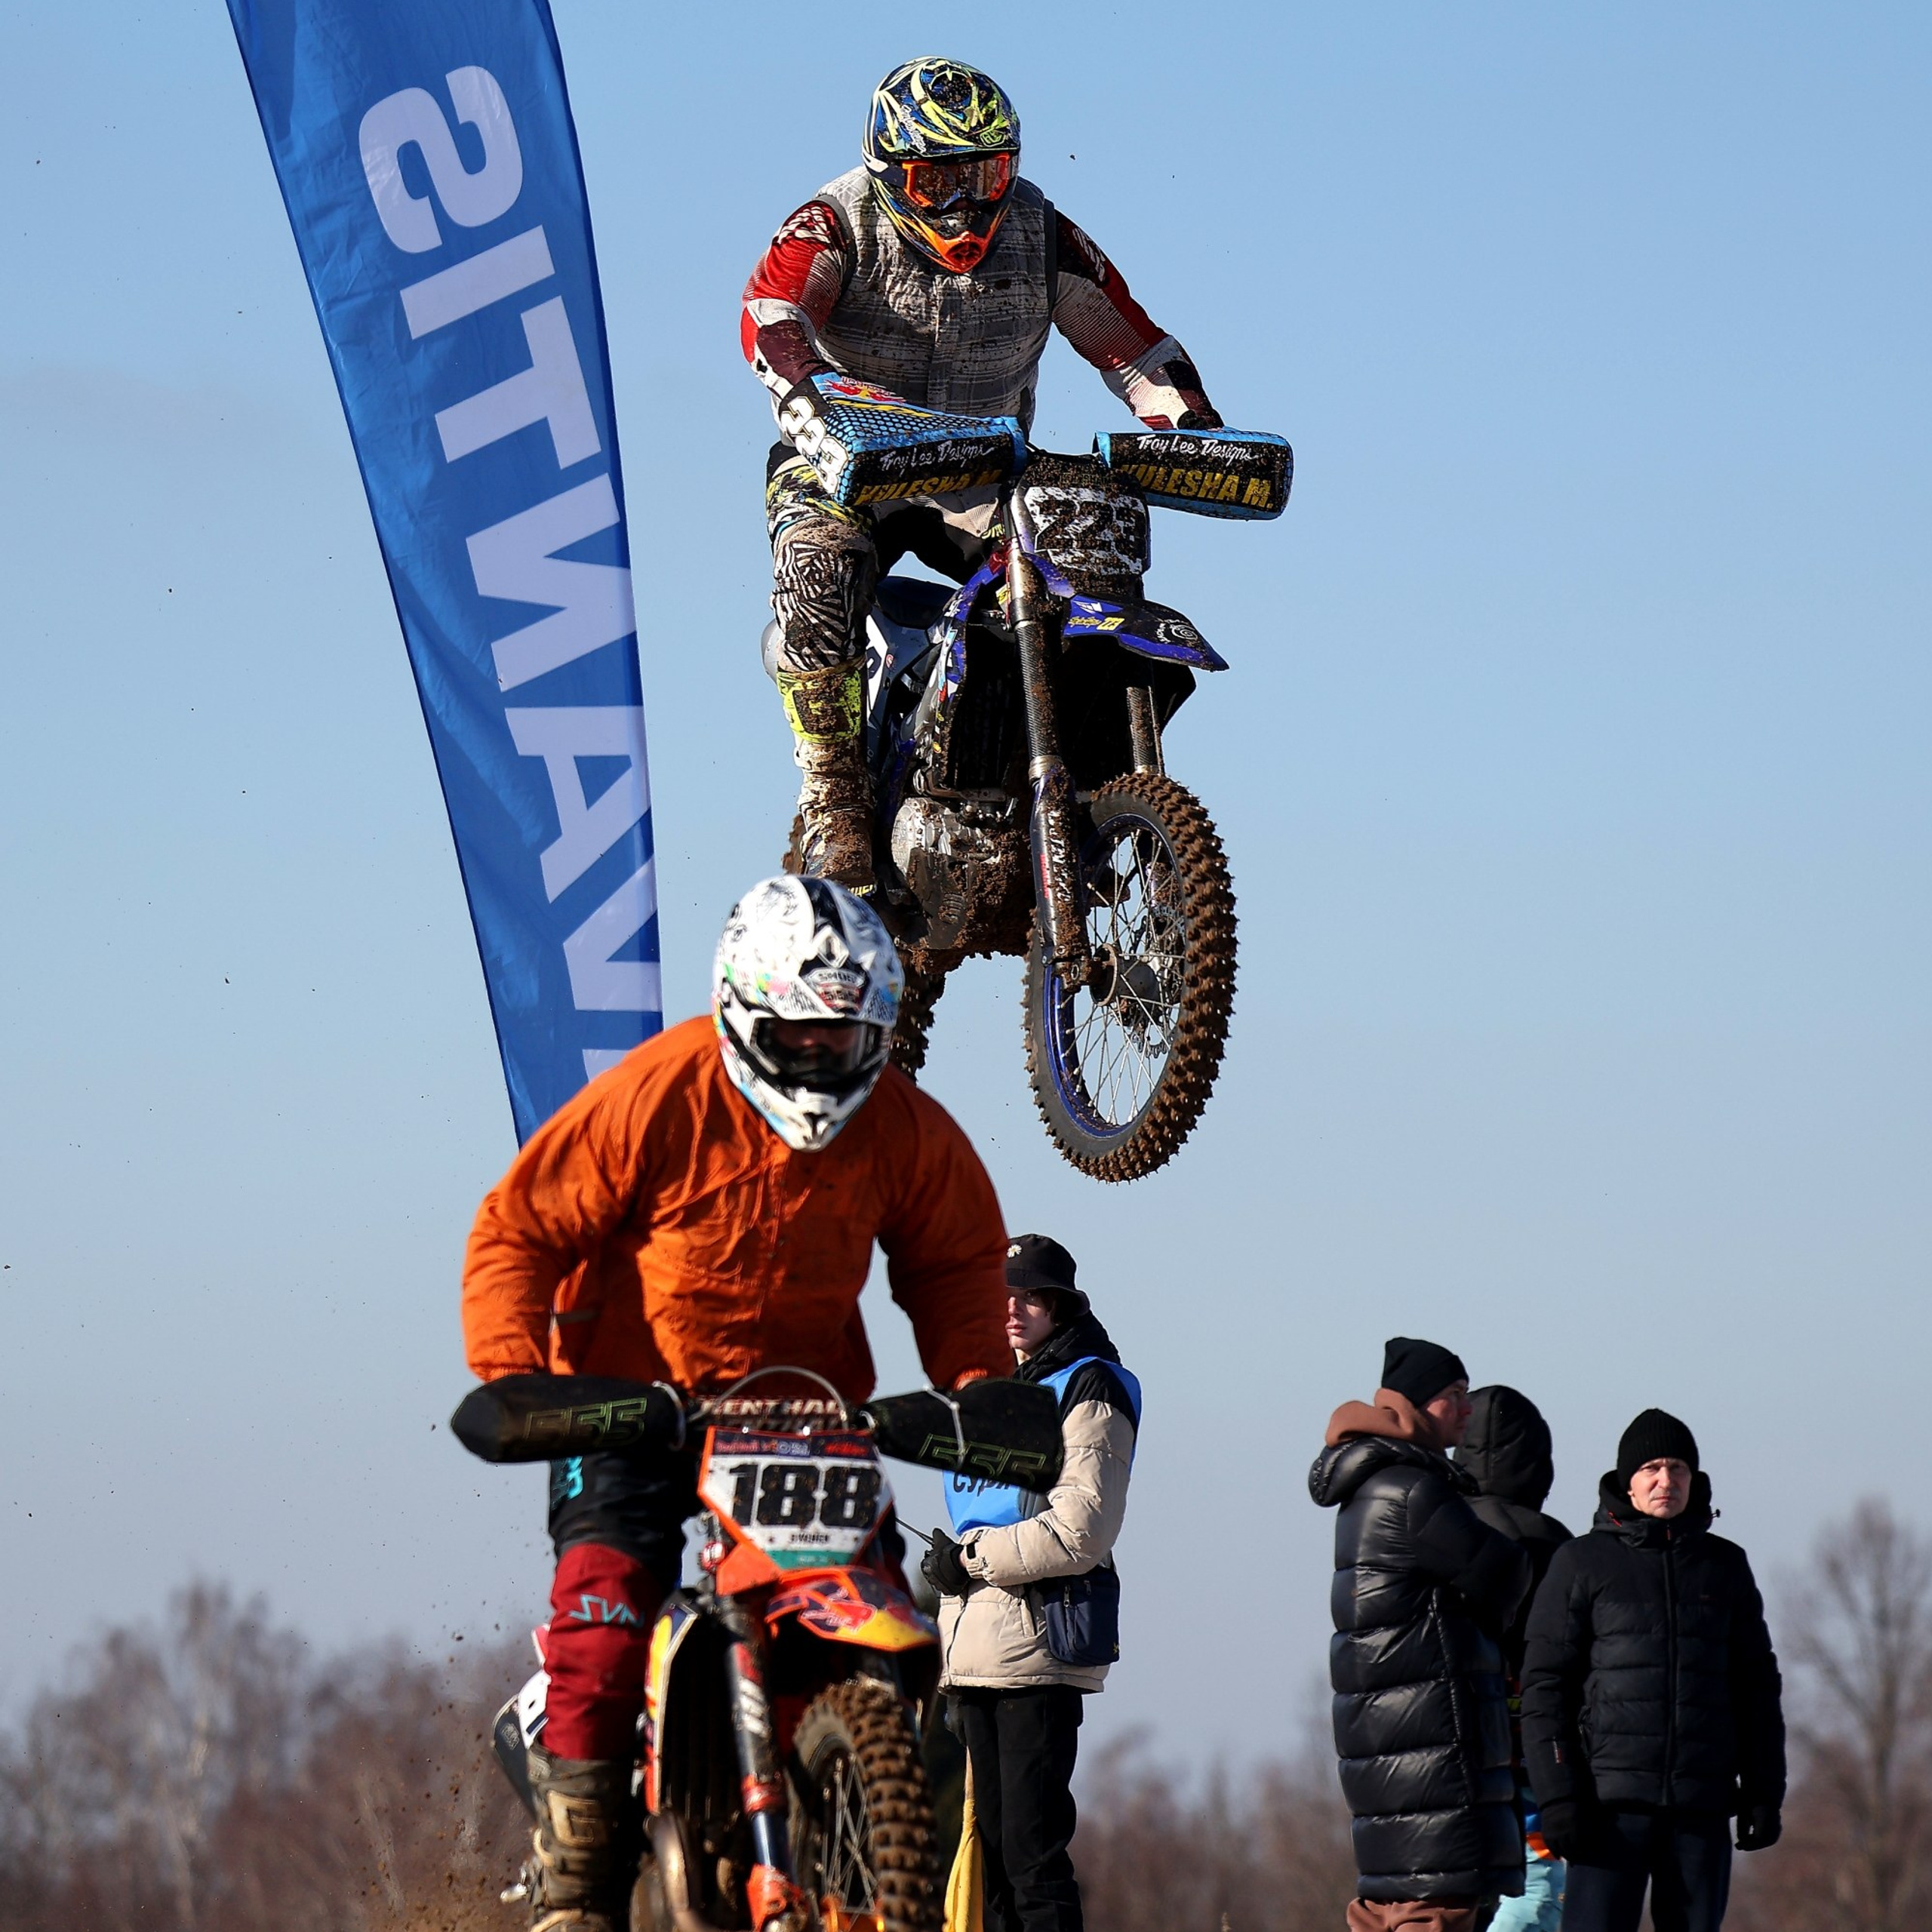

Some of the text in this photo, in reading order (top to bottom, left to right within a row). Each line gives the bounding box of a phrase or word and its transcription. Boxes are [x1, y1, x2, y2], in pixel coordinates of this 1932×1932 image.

[880, 440, 995, 477] Troy Lee Designs
[1137, 434, 1259, 467] Troy Lee Designs
[1242, 478, 1274, 509] M.
[729, 1463, 882, 1528] 188
